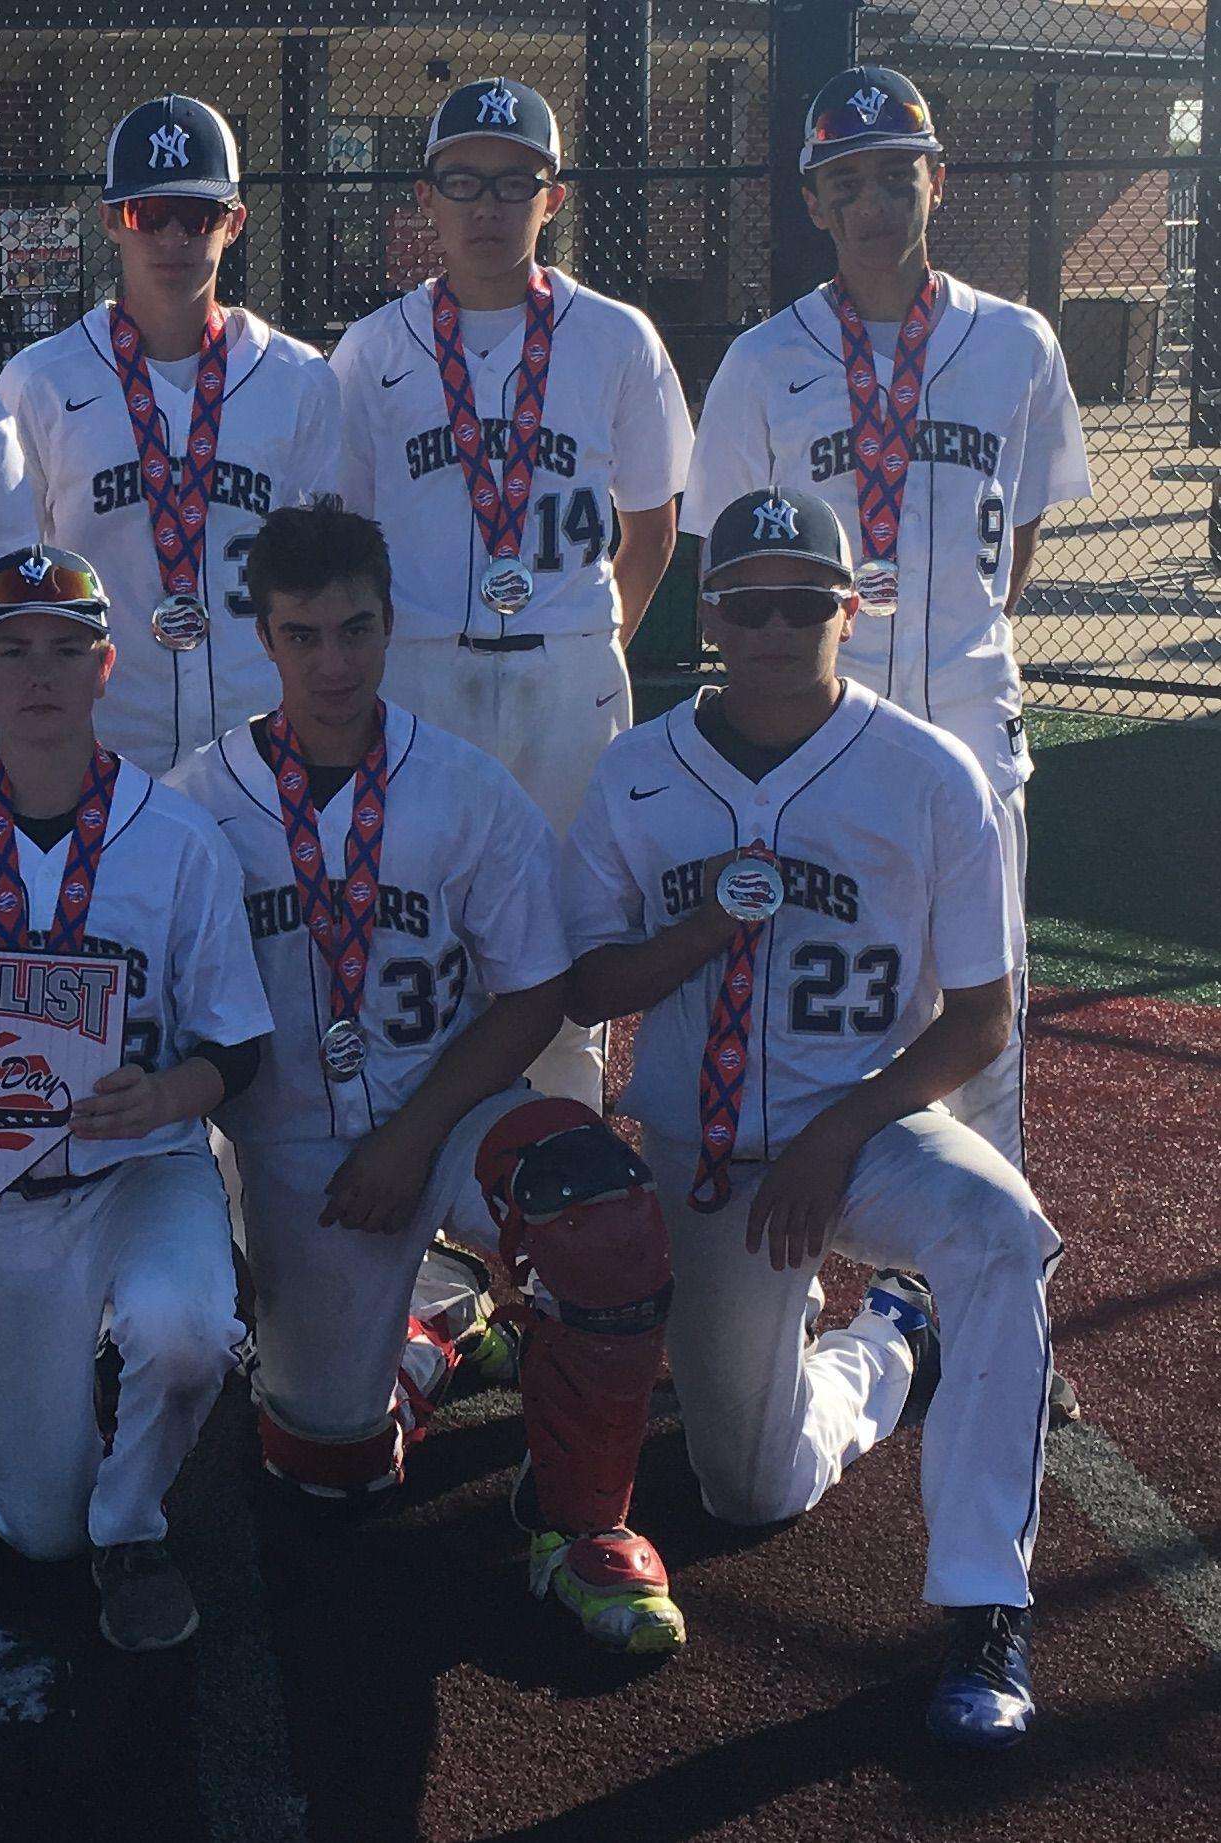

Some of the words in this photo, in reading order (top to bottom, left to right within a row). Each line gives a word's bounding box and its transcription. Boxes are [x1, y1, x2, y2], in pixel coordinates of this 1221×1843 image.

[532, 486, 606, 573] 14
[976, 495, 1006, 580] 9
[787, 940, 902, 1036] 23
[0, 1056, 64, 1103] Day
